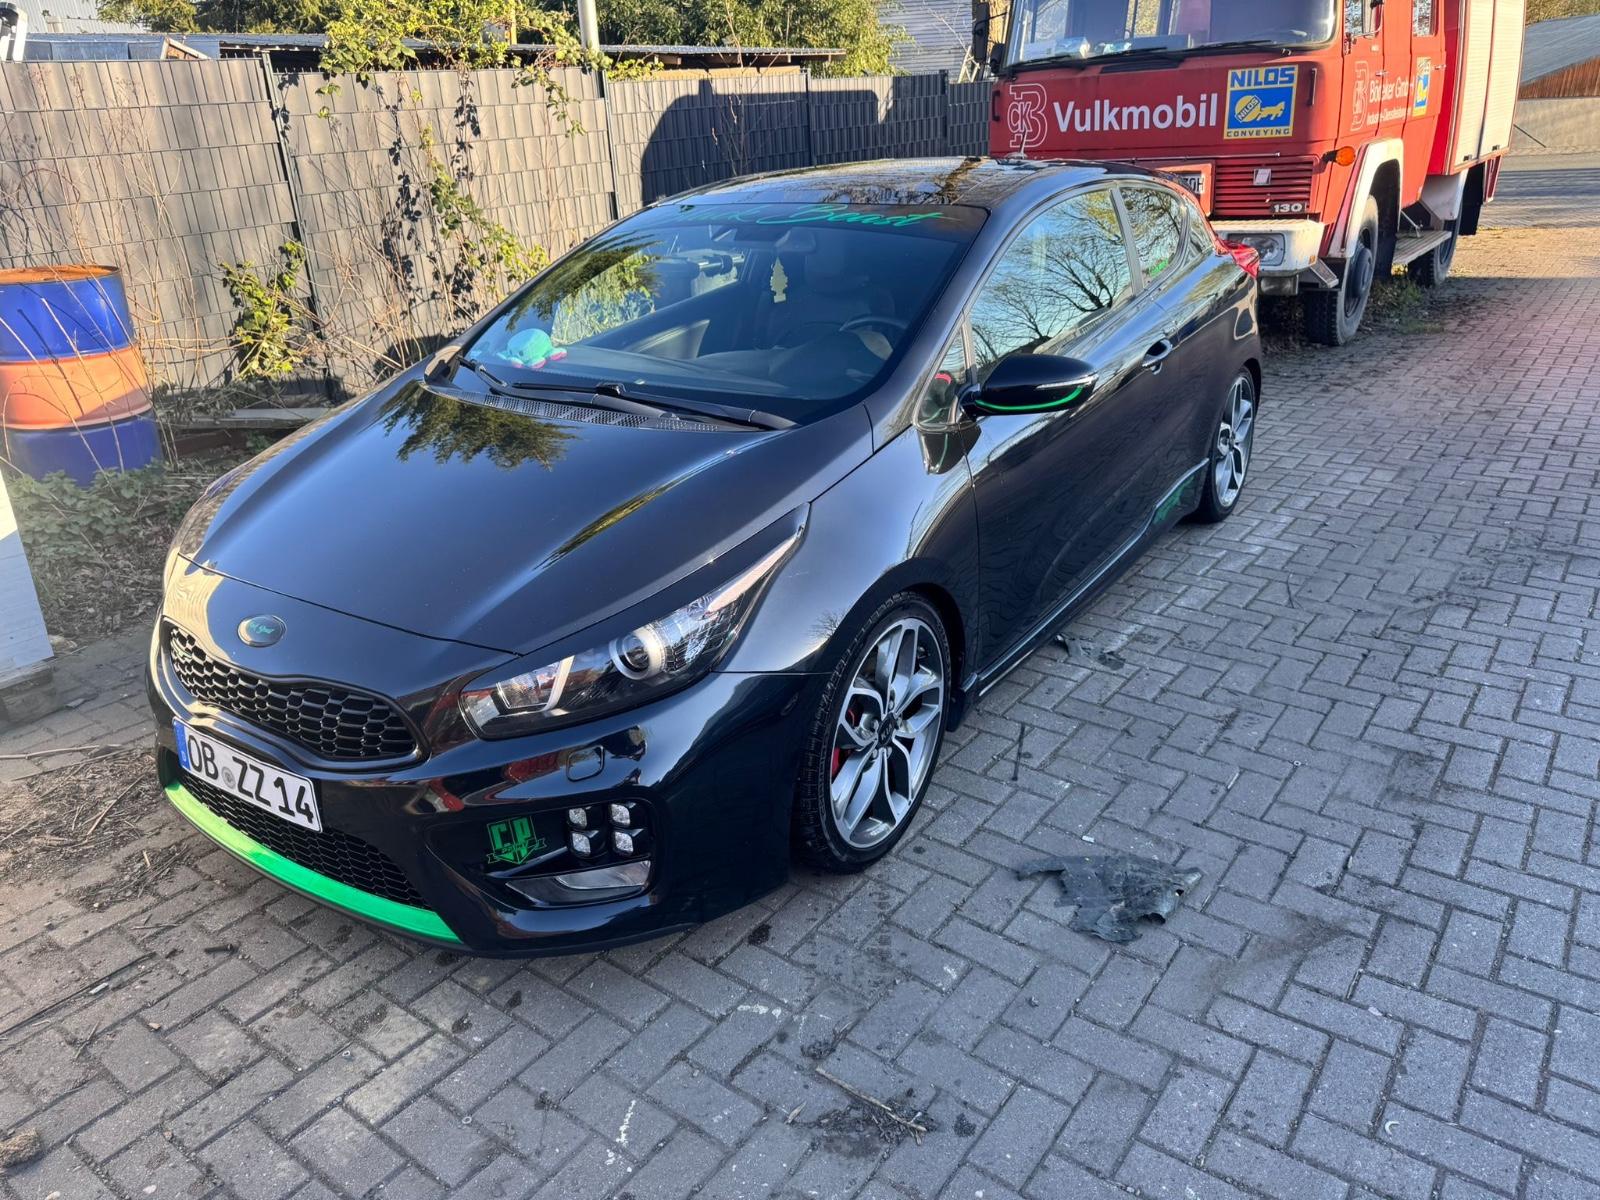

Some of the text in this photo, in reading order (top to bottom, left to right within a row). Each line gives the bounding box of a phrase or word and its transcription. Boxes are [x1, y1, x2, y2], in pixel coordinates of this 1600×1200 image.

[1230, 66, 1296, 88] NILOS
[1053, 93, 1218, 132] Vulkmobil
[1237, 97, 1259, 120] NILOS
[1226, 128, 1290, 138] CONVEYING
[1273, 203, 1303, 213] 130
[187, 734, 219, 780] OB
[231, 756, 272, 807] ZZ
[273, 776, 314, 824] 14
